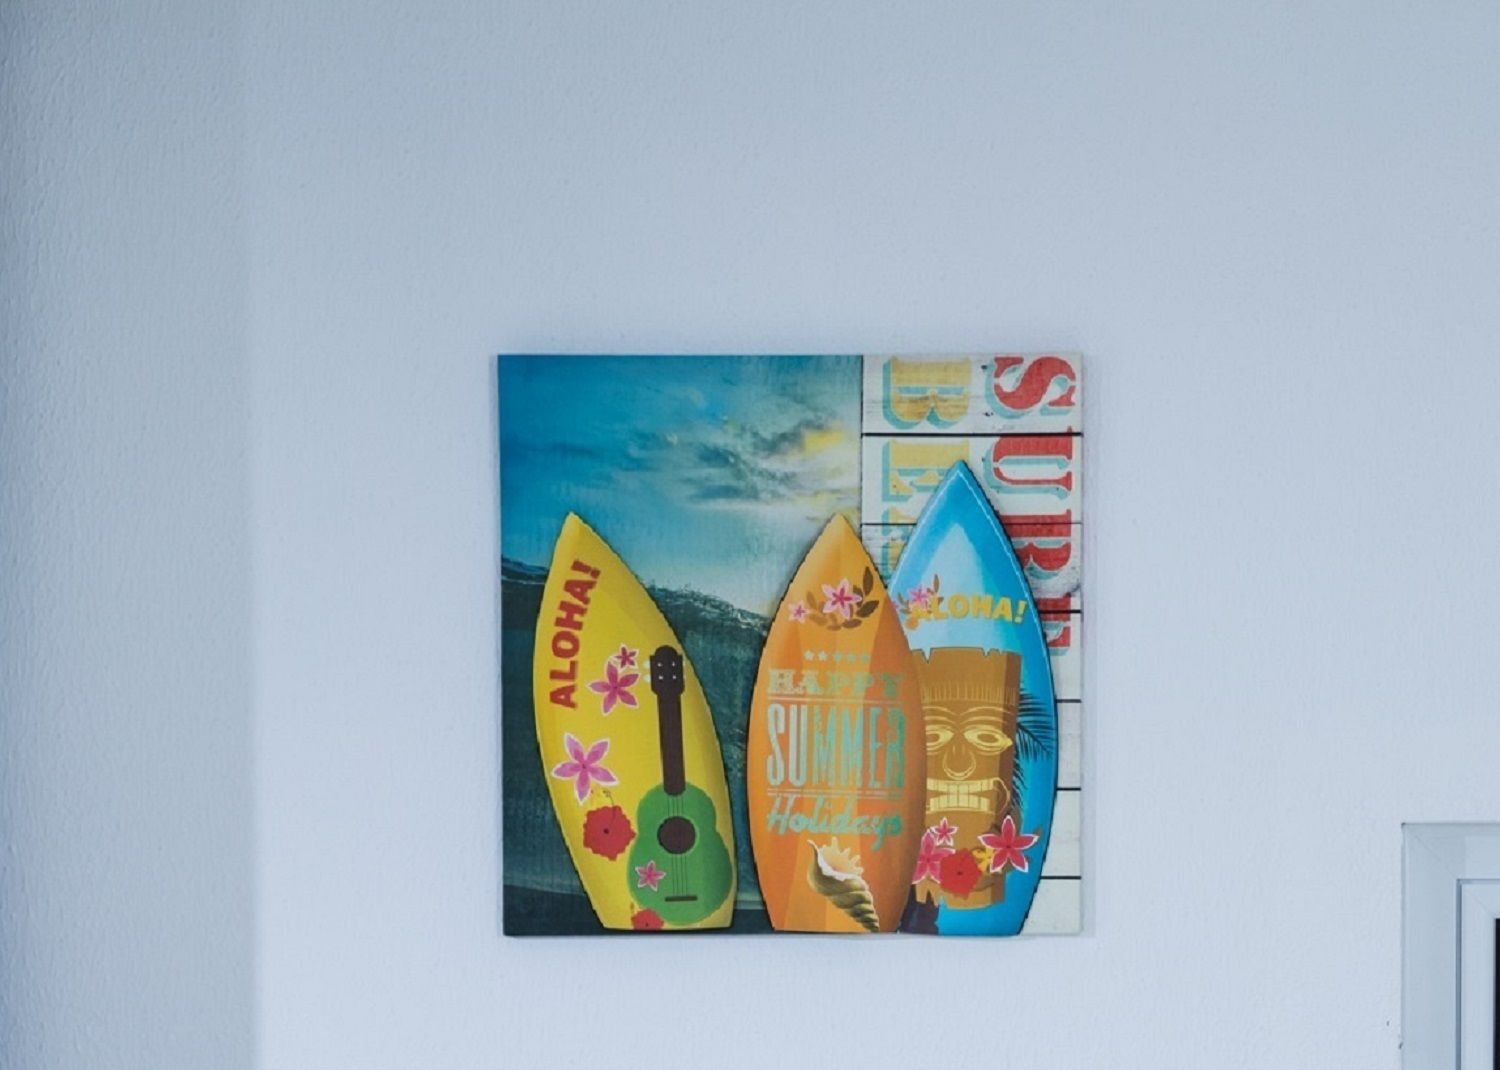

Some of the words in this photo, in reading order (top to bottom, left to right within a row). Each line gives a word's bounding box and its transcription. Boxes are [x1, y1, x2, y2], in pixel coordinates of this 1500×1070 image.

[549, 558, 601, 710] ALOHA!
[766, 668, 904, 697] HAPPY
[766, 703, 907, 788] SUMMER
[766, 794, 904, 852] Holidays
